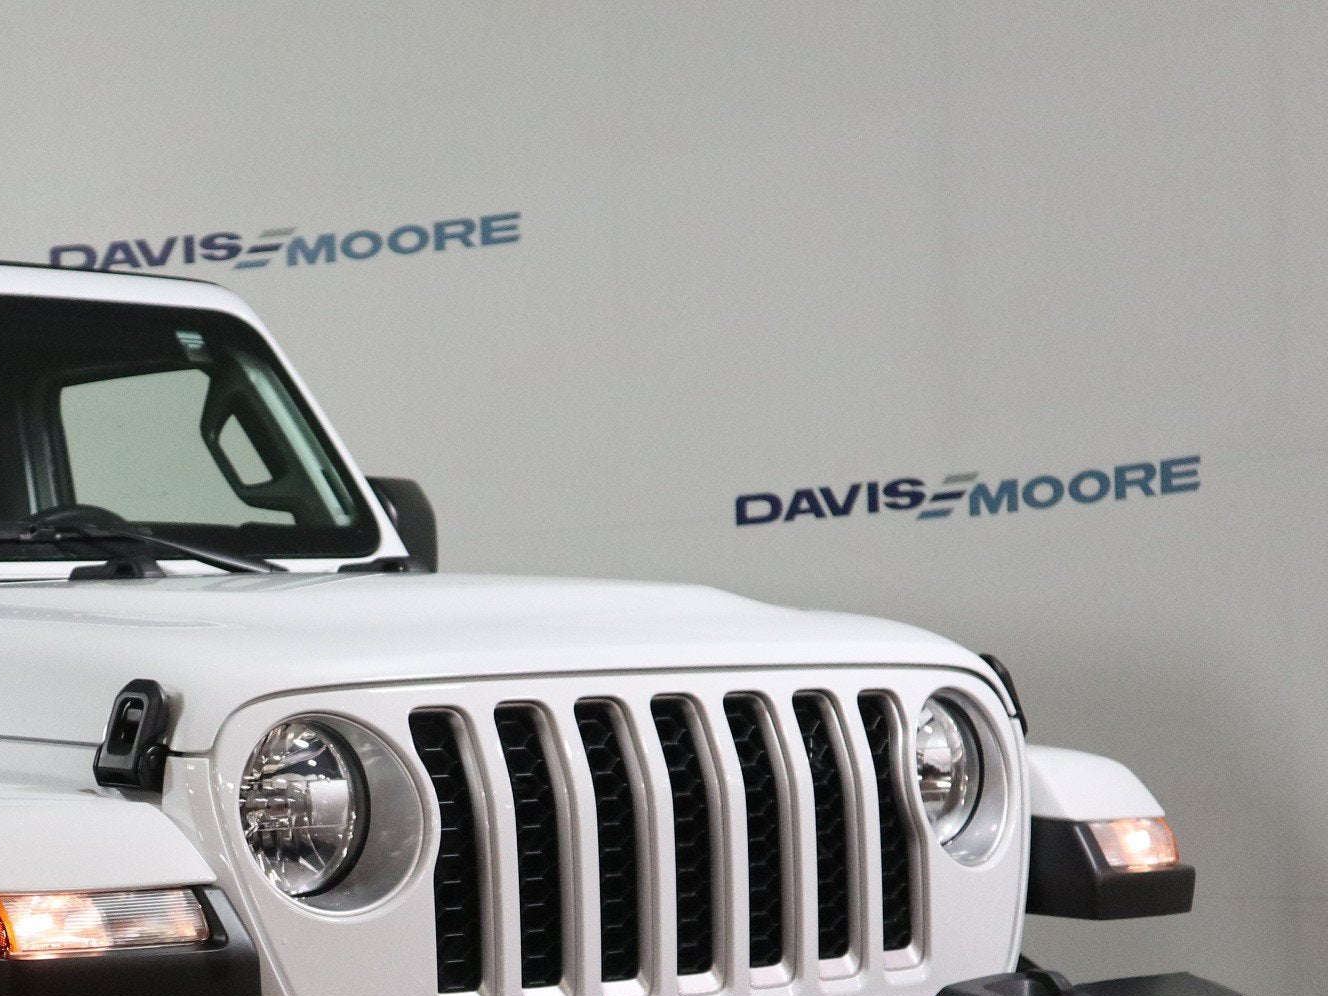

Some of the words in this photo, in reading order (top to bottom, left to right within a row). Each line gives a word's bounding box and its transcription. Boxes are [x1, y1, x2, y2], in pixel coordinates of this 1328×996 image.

[48, 231, 243, 271] DAVIS
[285, 210, 522, 268] MOORE
[734, 476, 927, 527] DAVIS
[968, 454, 1201, 517] MOORE
